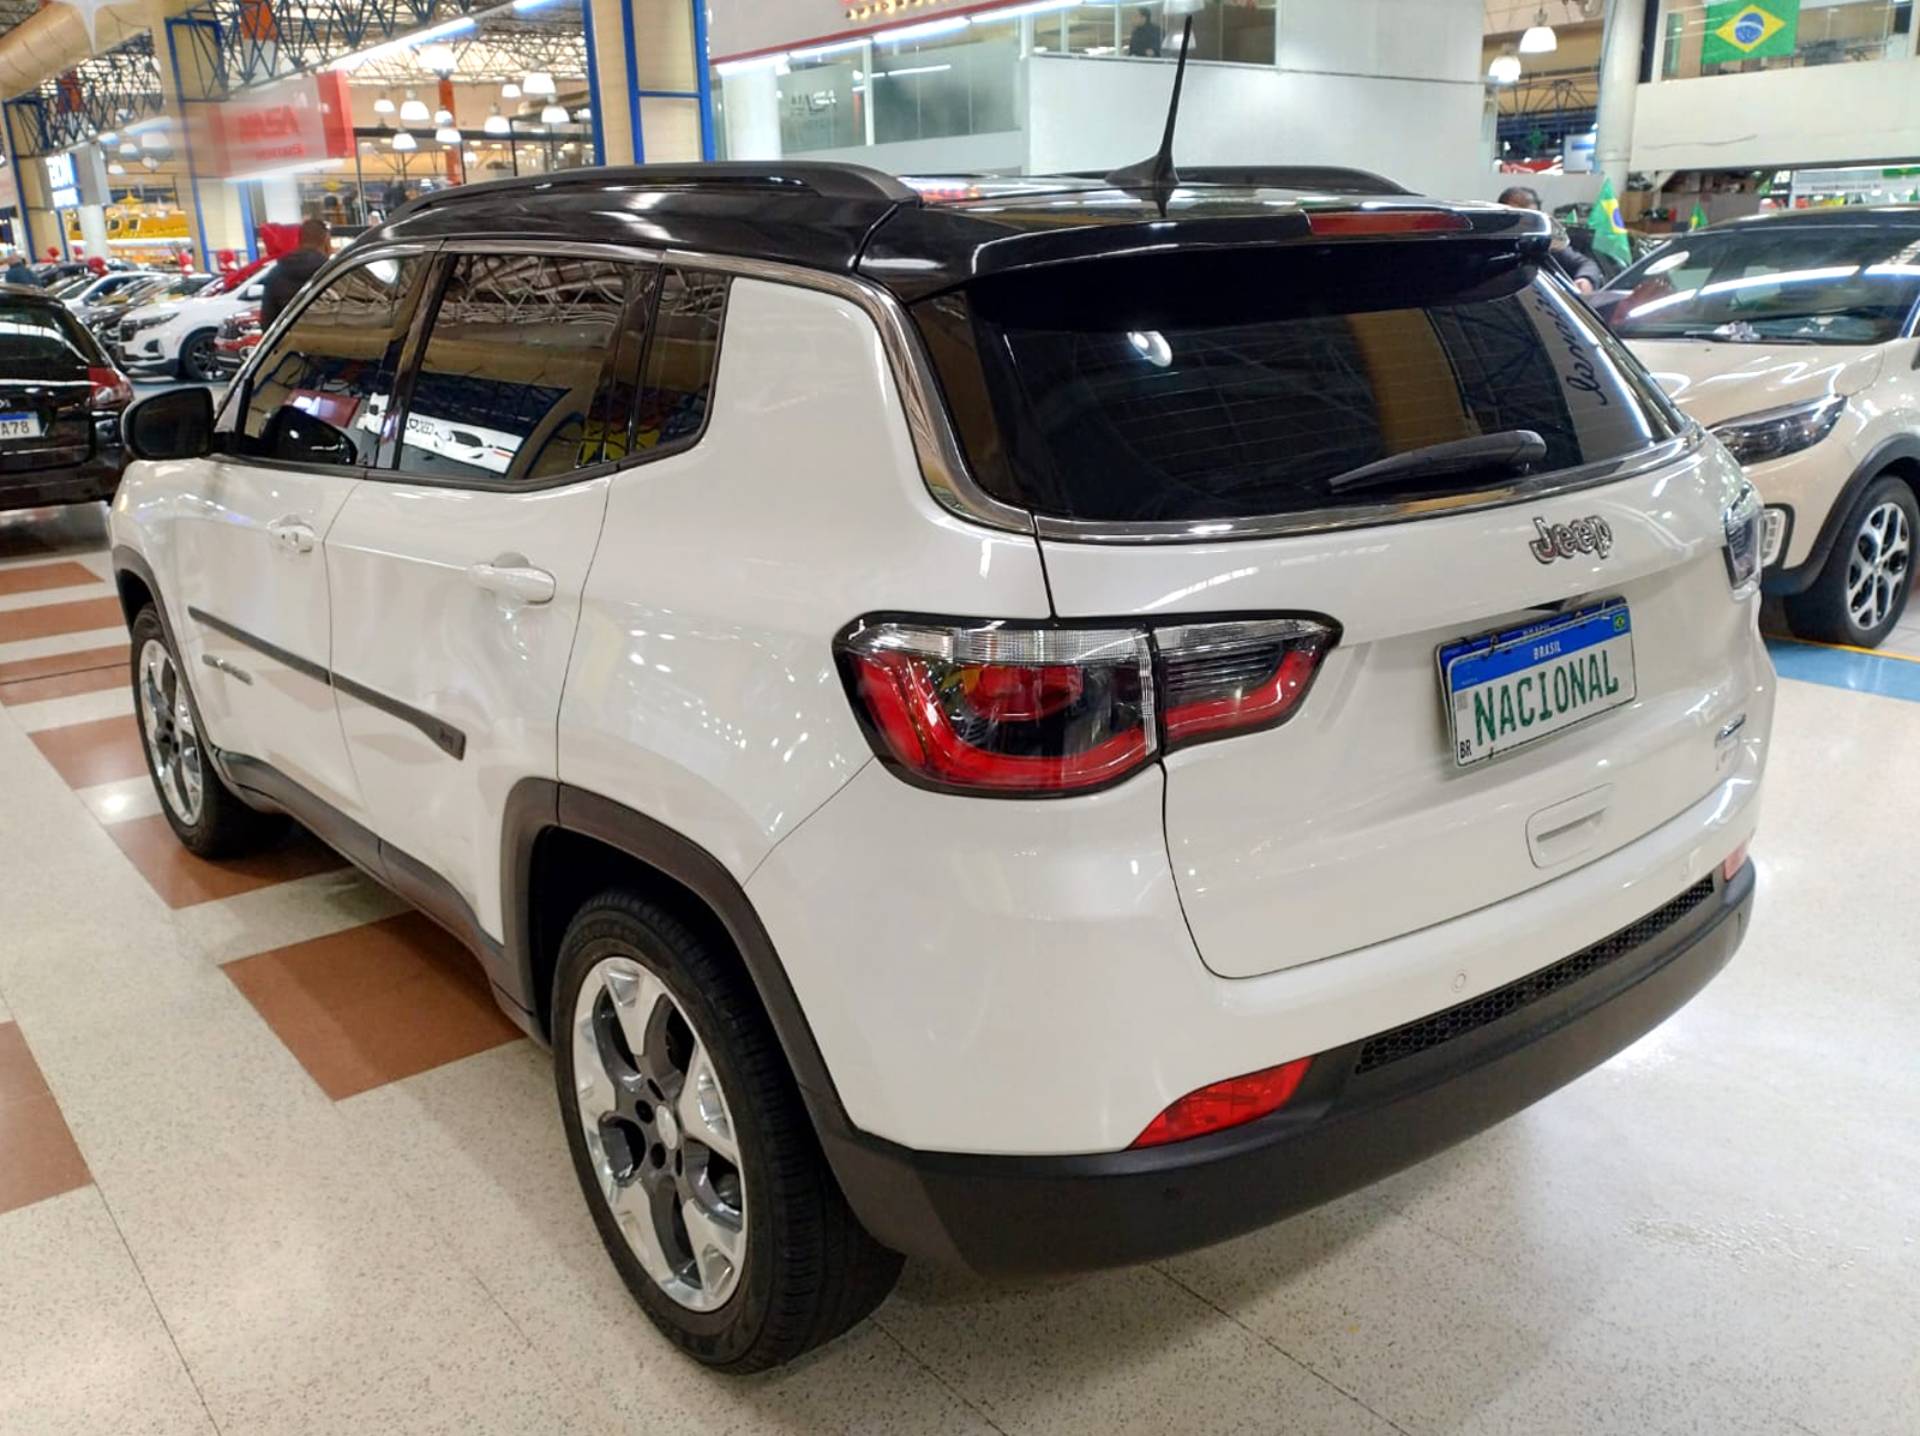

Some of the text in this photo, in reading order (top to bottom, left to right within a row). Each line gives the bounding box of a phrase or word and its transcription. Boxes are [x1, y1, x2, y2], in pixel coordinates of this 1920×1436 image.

[1529, 515, 1612, 564] Jeep
[1533, 641, 1562, 660] BRASIL
[1474, 650, 1619, 747] NACIONAL
[1459, 740, 1472, 758] BR
